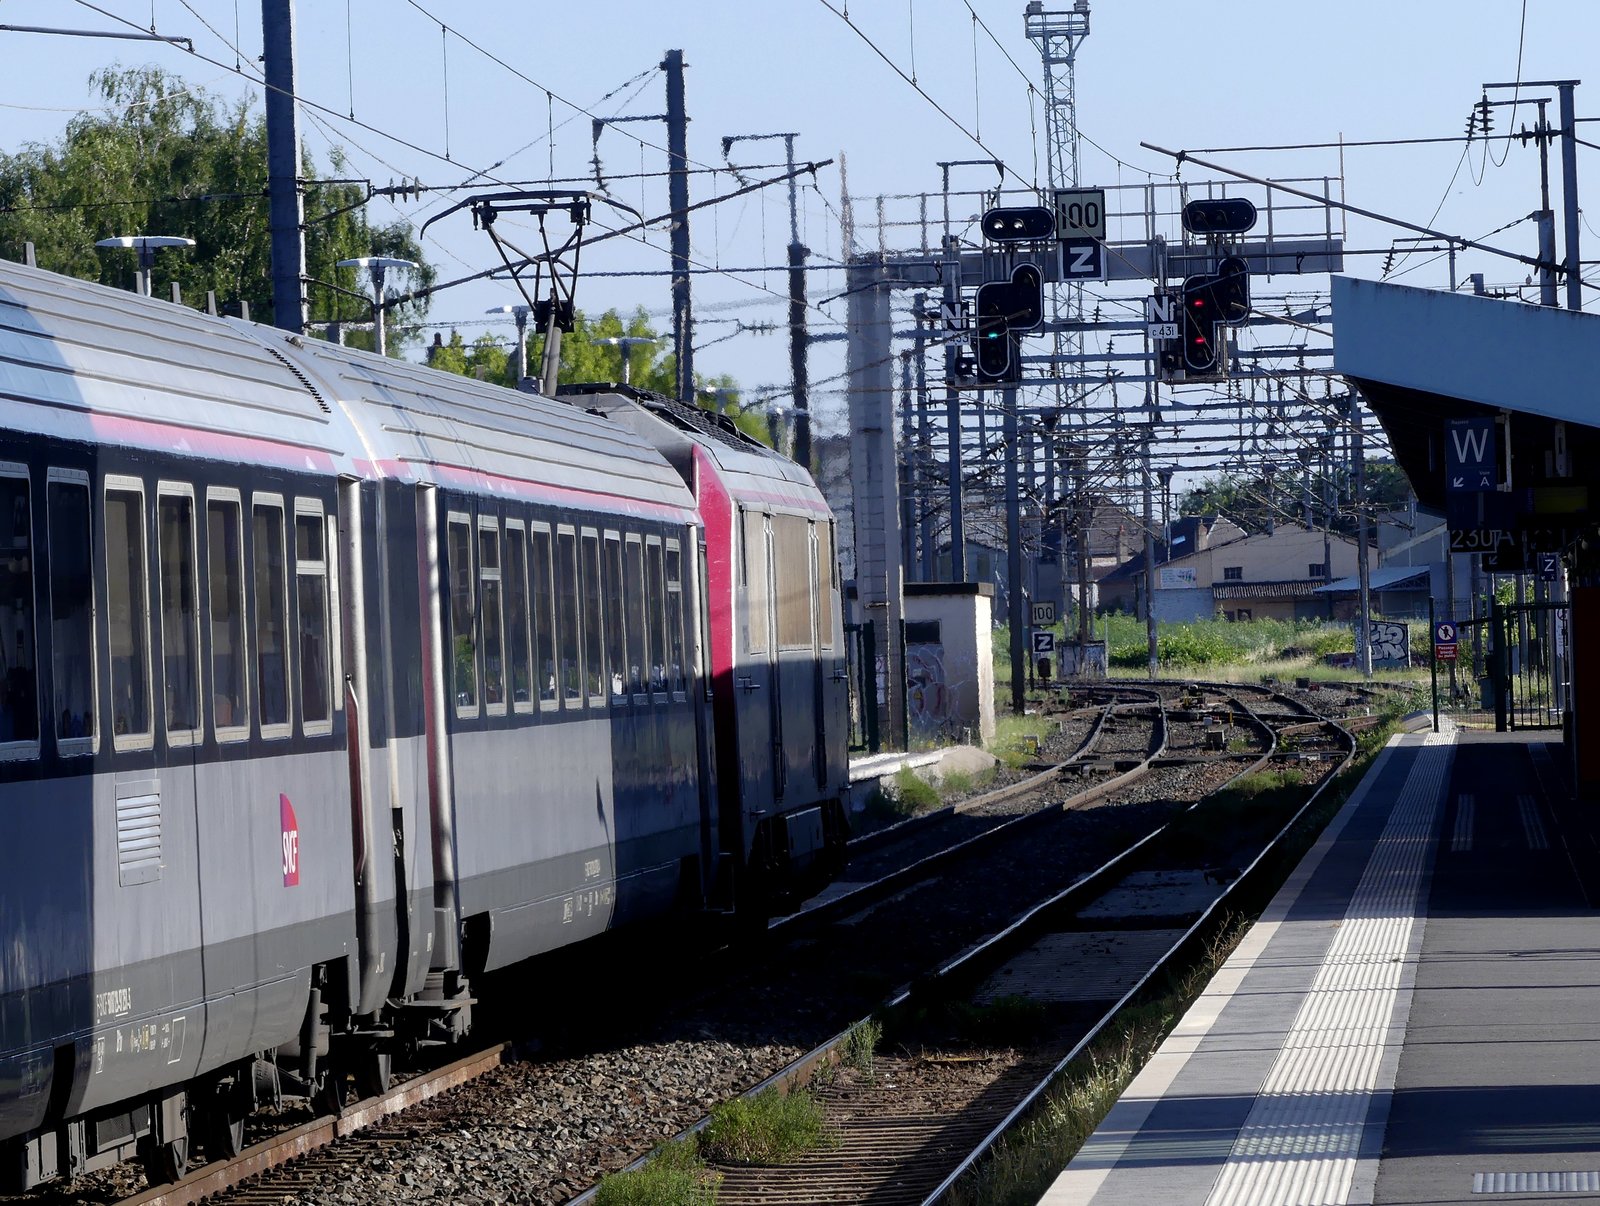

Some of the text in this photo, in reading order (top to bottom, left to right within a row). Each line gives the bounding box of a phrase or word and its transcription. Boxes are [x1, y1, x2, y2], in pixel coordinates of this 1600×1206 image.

[1061, 202, 1099, 230] 100
[1069, 246, 1094, 273] Z
[1148, 296, 1177, 322] Nf
[1451, 428, 1489, 463] W
[1480, 476, 1490, 487] A
[1544, 559, 1555, 572] Z
[1034, 606, 1053, 620] 100
[1038, 635, 1051, 650] Z
[282, 830, 298, 876] SNCF
